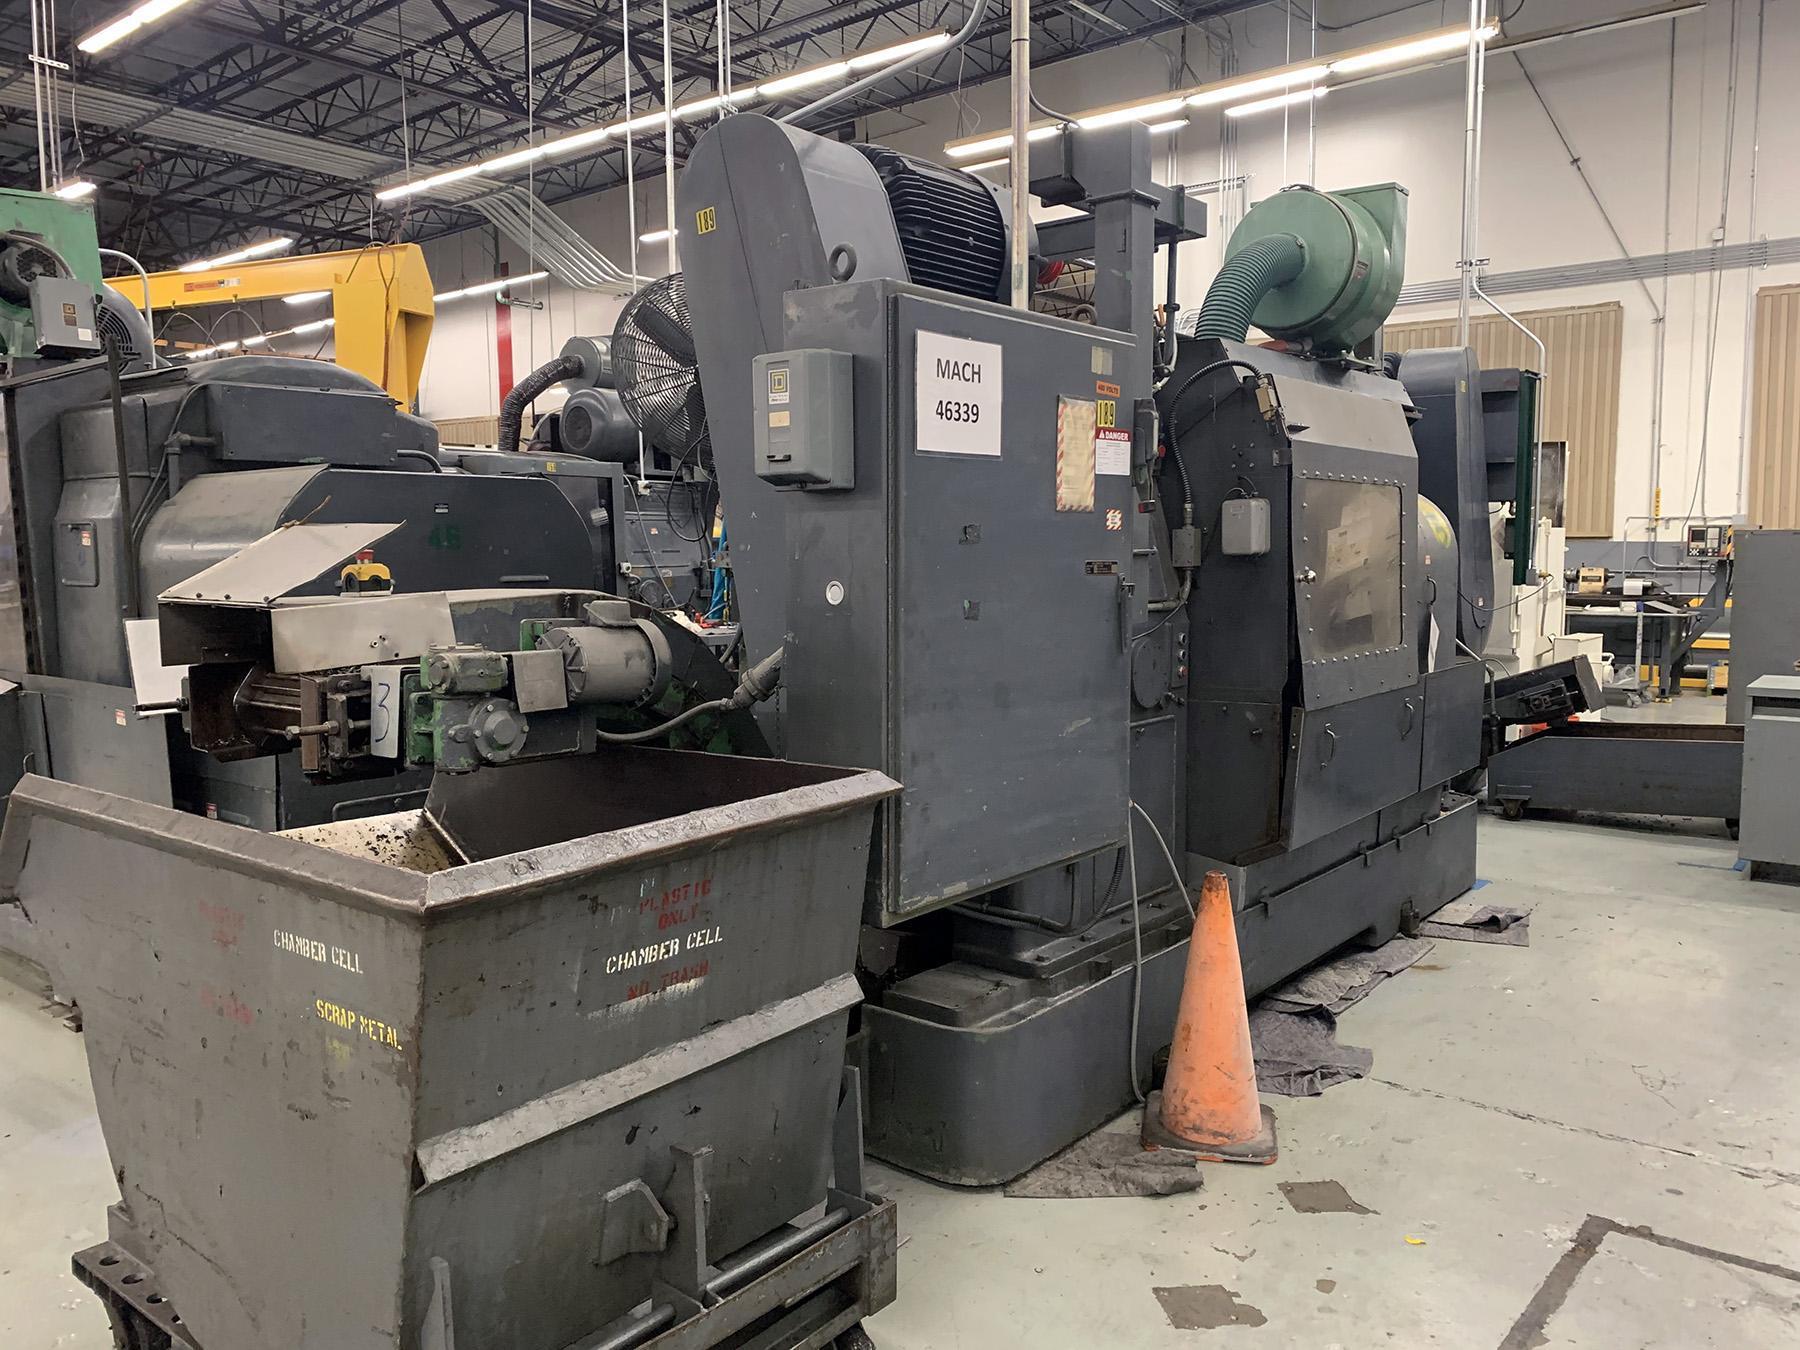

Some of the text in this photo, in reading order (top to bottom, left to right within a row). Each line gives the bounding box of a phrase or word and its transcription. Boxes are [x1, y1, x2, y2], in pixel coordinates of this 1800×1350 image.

[698, 208, 716, 233] 189
[936, 357, 982, 384] MACH
[1106, 386, 1119, 395] VOLTS
[935, 399, 980, 424] 46339
[1099, 402, 1115, 426] 189
[1105, 430, 1129, 441] DANGER
[375, 682, 391, 743] 3
[273, 929, 326, 963] CHAMBER
[331, 945, 364, 974] CELL
[606, 926, 723, 974] CHAMBER CELL
[316, 999, 403, 1051] SCRAP METAL
